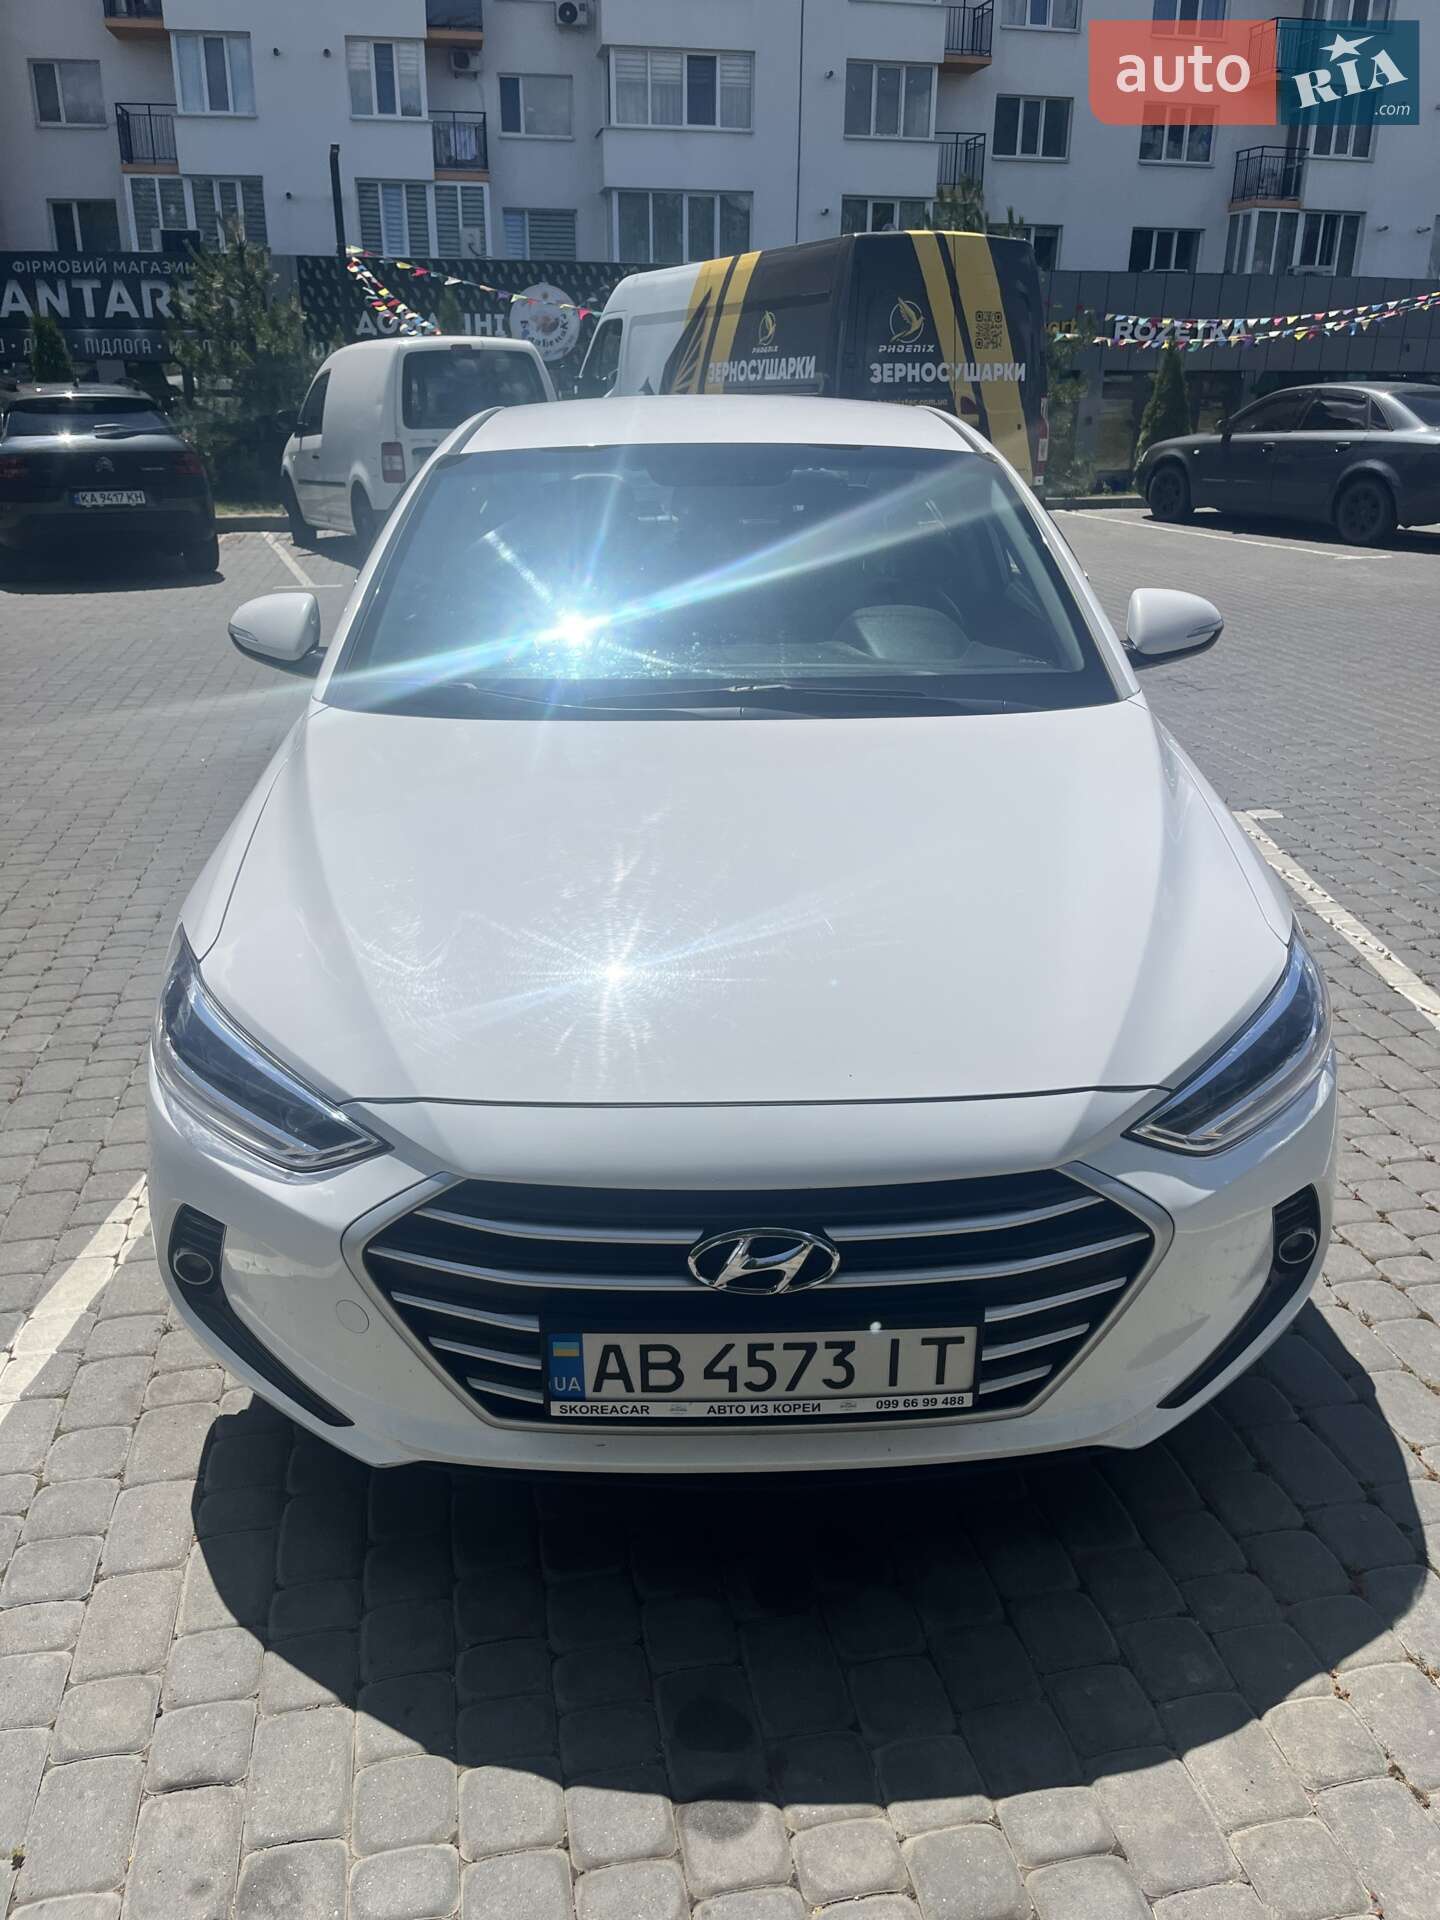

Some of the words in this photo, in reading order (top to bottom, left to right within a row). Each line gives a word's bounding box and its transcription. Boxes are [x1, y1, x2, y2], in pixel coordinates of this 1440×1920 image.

[12, 258, 107, 274] ФІРМОВИЙ
[1114, 322, 1247, 342] ROZETKA
[85, 338, 152, 356] ПІДЛОГА
[878, 345, 935, 353] PHOENIX
[708, 356, 816, 383] ЗЕРНОСУШАРКИ
[869, 363, 1026, 383] ЗЕРНОСУШАРКИ
[592, 1343, 685, 1392] AB
[702, 1339, 856, 1392] 4573
[553, 1375, 581, 1393] UA
[559, 1404, 650, 1415] SKOREACAR
[706, 1404, 747, 1415] АВТО
[750, 1404, 769, 1414] ИЗ
[876, 1399, 900, 1410] 099
[902, 1398, 919, 1409] 66
[922, 1397, 938, 1408] 99
[941, 1396, 965, 1408] 488
